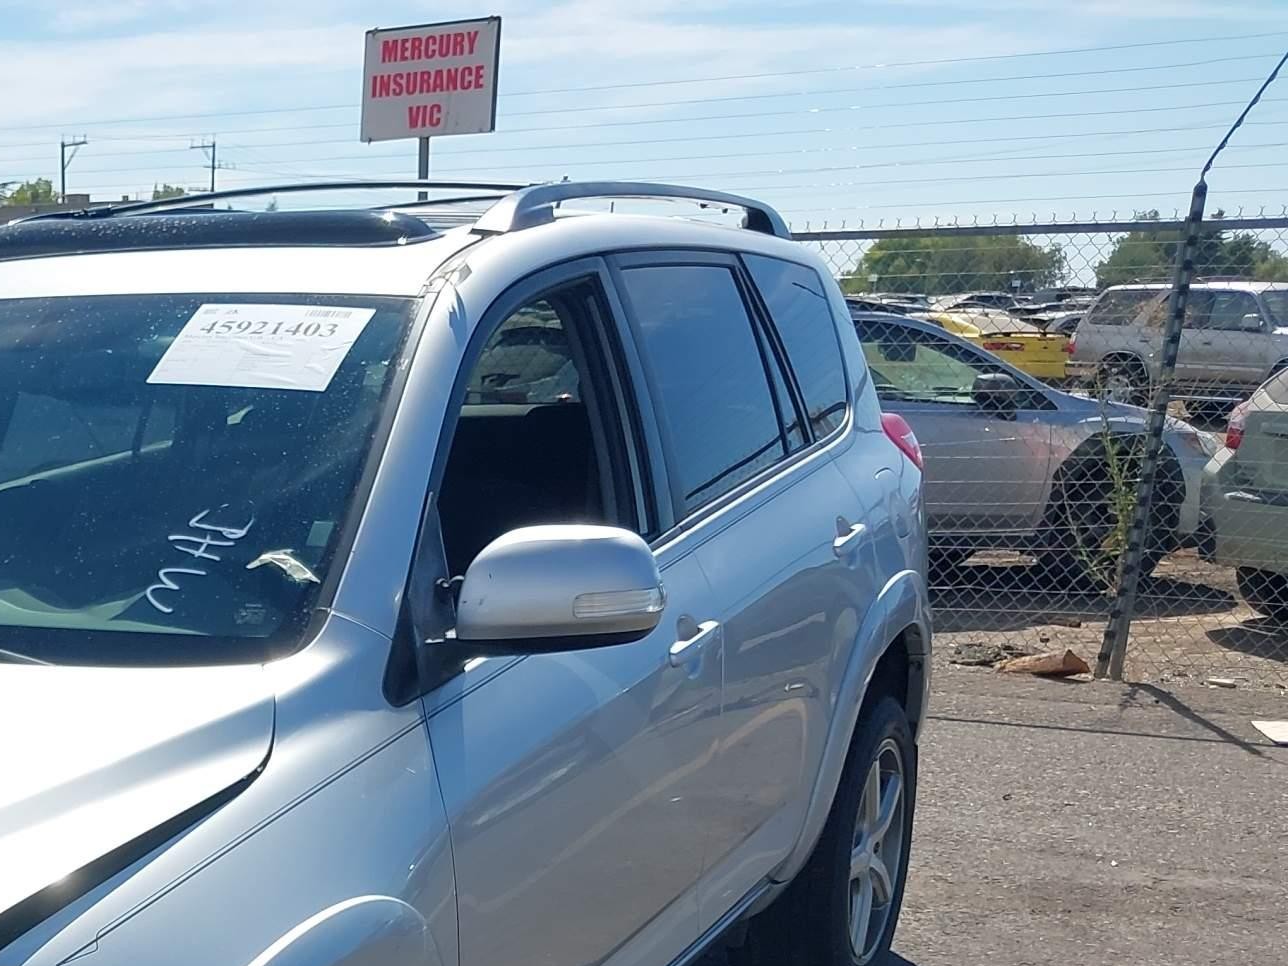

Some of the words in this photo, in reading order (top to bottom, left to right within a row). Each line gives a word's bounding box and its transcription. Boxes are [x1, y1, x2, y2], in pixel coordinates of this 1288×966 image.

[381, 30, 479, 63] MERCURY
[371, 65, 485, 98] INSURANCE
[408, 103, 442, 129] VIC
[199, 319, 339, 338] 45921403
